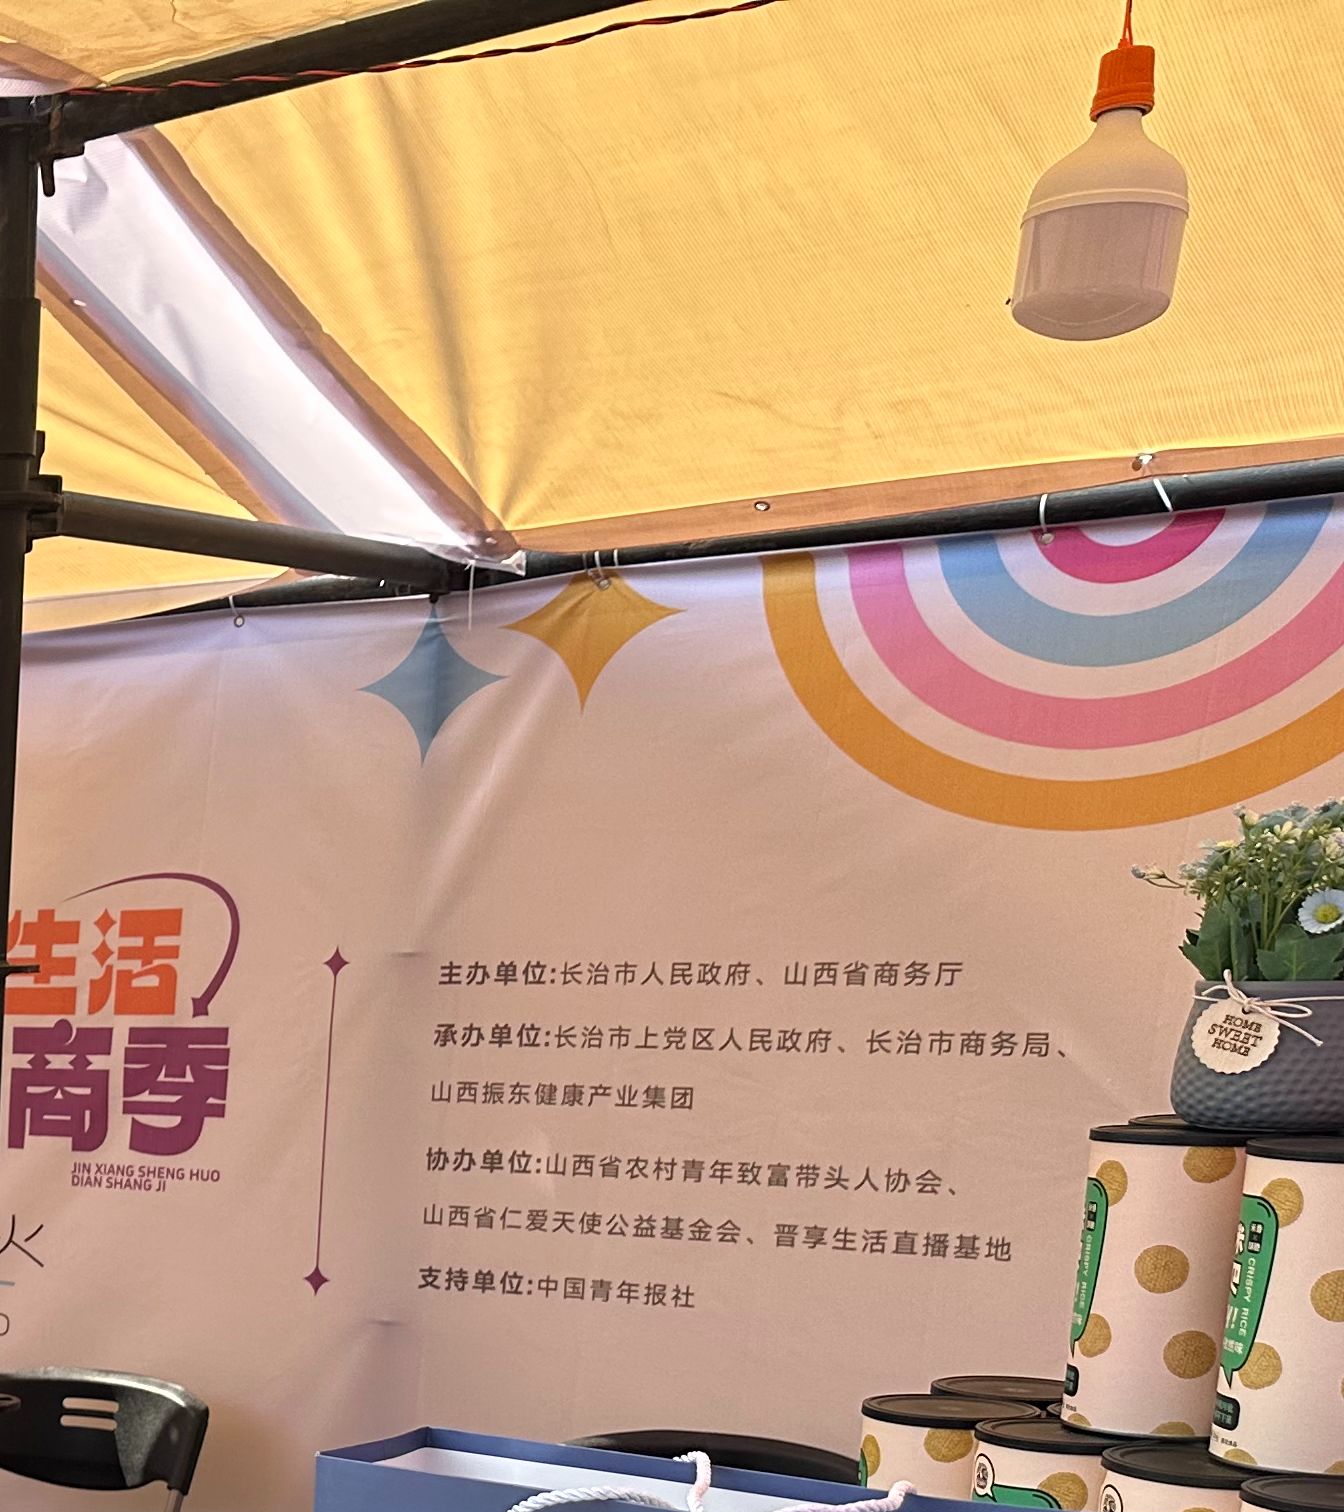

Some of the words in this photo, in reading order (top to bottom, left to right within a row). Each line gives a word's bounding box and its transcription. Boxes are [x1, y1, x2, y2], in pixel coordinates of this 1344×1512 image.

[1222, 1014, 1263, 1033] HOME
[1207, 1023, 1263, 1047] SWEET
[1211, 1037, 1251, 1057] HOME
[430, 1080, 695, 1110] 山西振东健康产业集团
[71, 1162, 92, 1175] JIN
[95, 1163, 135, 1178] XIANG
[138, 1166, 185, 1181] SHENG
[189, 1168, 221, 1183] HUO
[71, 1174, 103, 1188] DIAN
[105, 1176, 153, 1191] SHANG
[156, 1180, 167, 1193] JI
